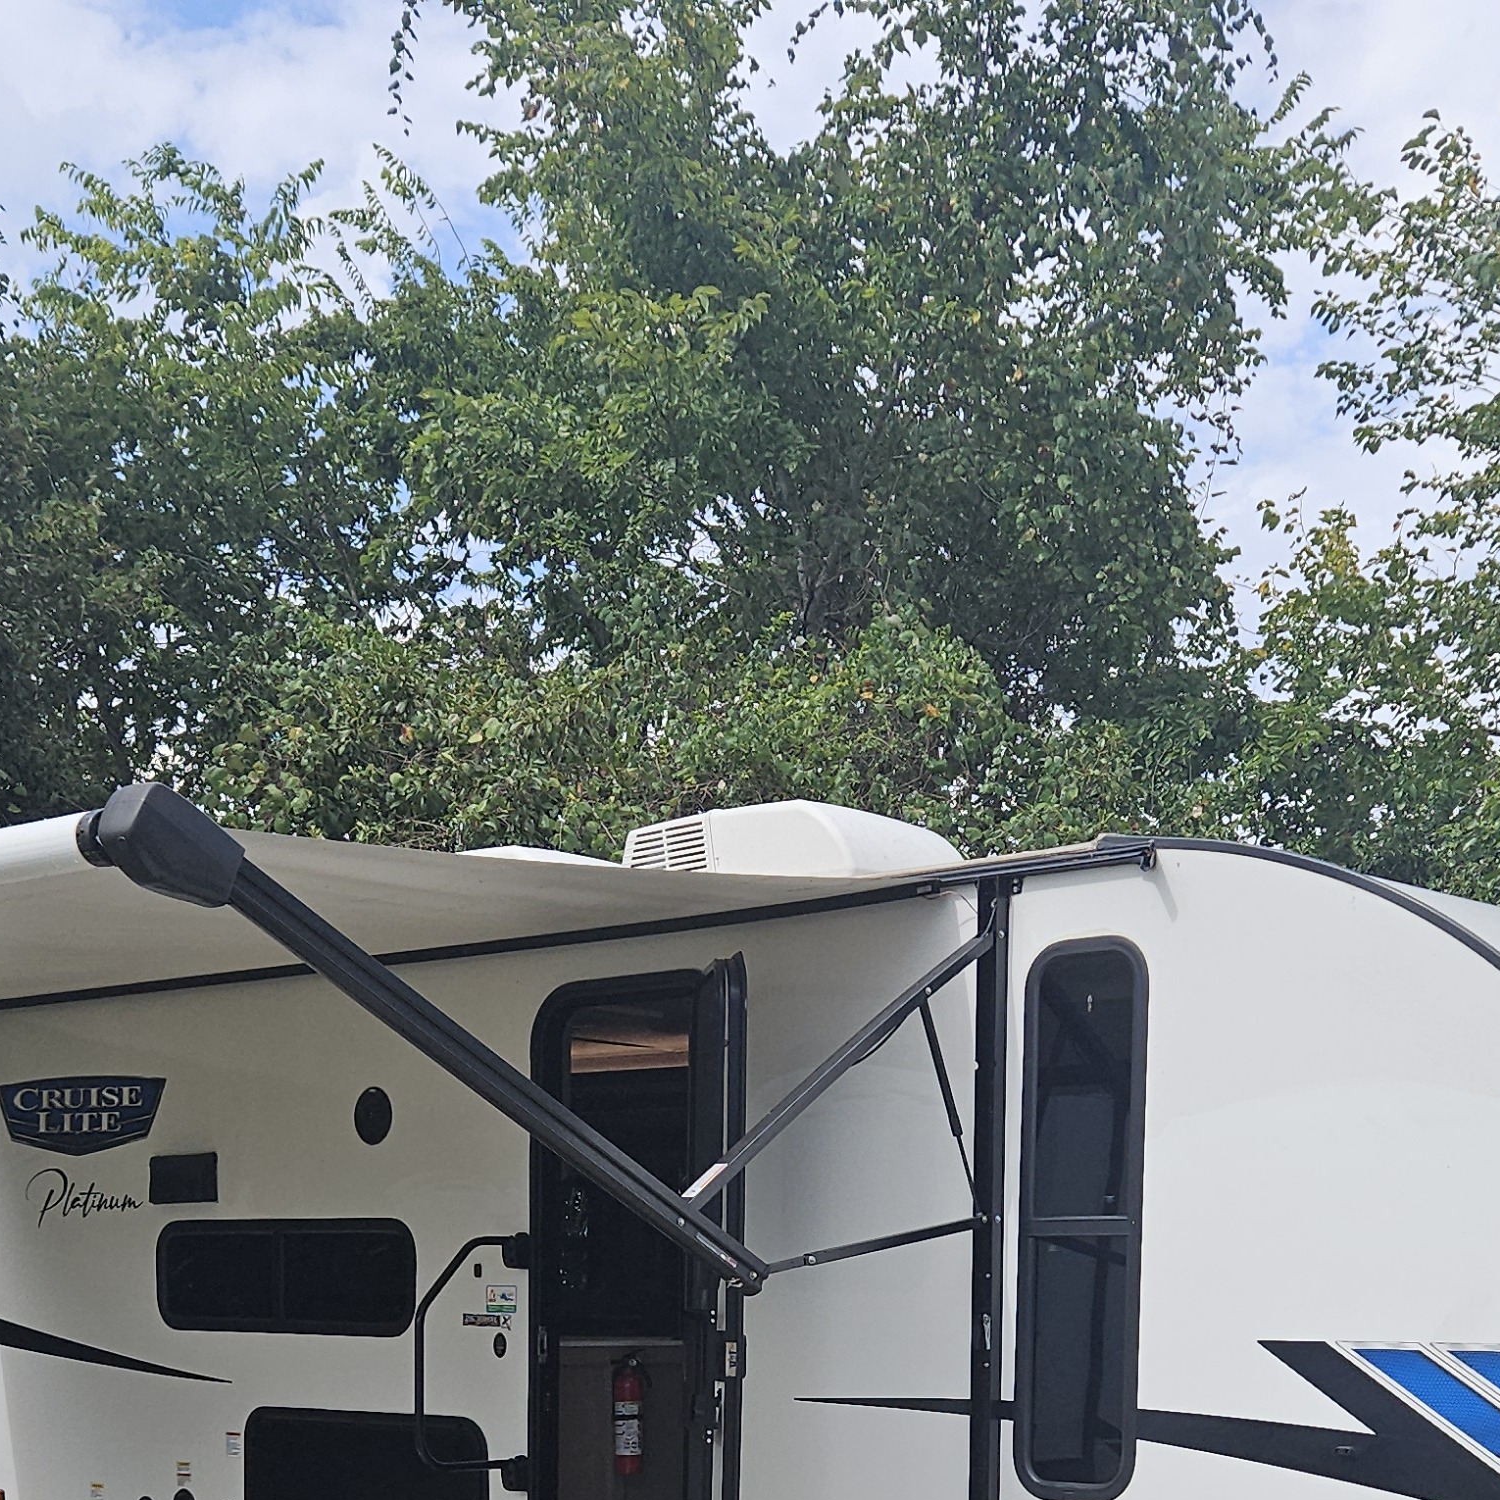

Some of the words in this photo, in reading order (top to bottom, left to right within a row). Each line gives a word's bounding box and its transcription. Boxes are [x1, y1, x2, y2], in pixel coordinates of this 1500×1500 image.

[13, 1085, 143, 1111] CRUISE
[36, 1111, 122, 1133] LITE
[25, 1168, 143, 1228] Platinum
